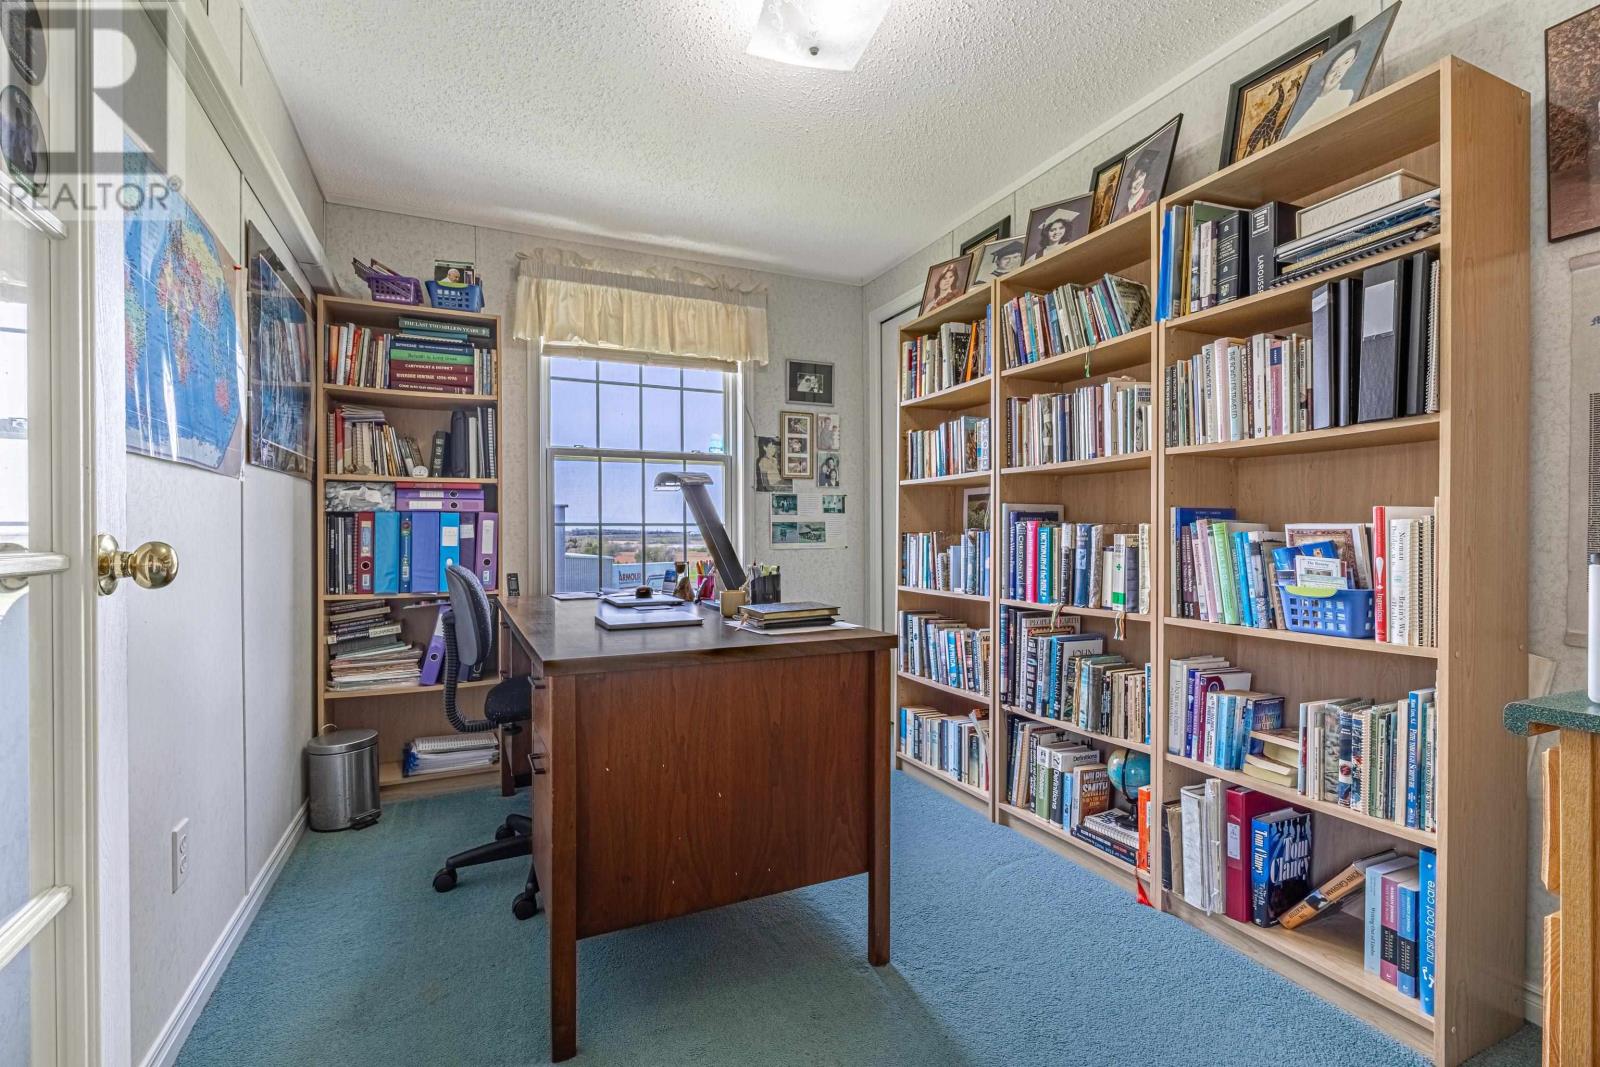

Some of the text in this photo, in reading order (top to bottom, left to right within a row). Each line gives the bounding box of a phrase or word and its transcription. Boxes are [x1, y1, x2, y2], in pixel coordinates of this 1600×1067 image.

[1040, 532, 1048, 563] DICTIONARY
[1398, 532, 1406, 561] Norman
[1040, 578, 1048, 596] BIBLE
[1397, 596, 1406, 638] Brain's Way
[1072, 753, 1097, 762] Definitions
[1052, 769, 1060, 810] Definitions
[1082, 782, 1108, 793] SMITH
[1252, 829, 1268, 875] Tom Clancy
[1283, 837, 1308, 861] Tom
[1270, 855, 1311, 883] Clancy
[1426, 880, 1437, 964] nursing foot care
